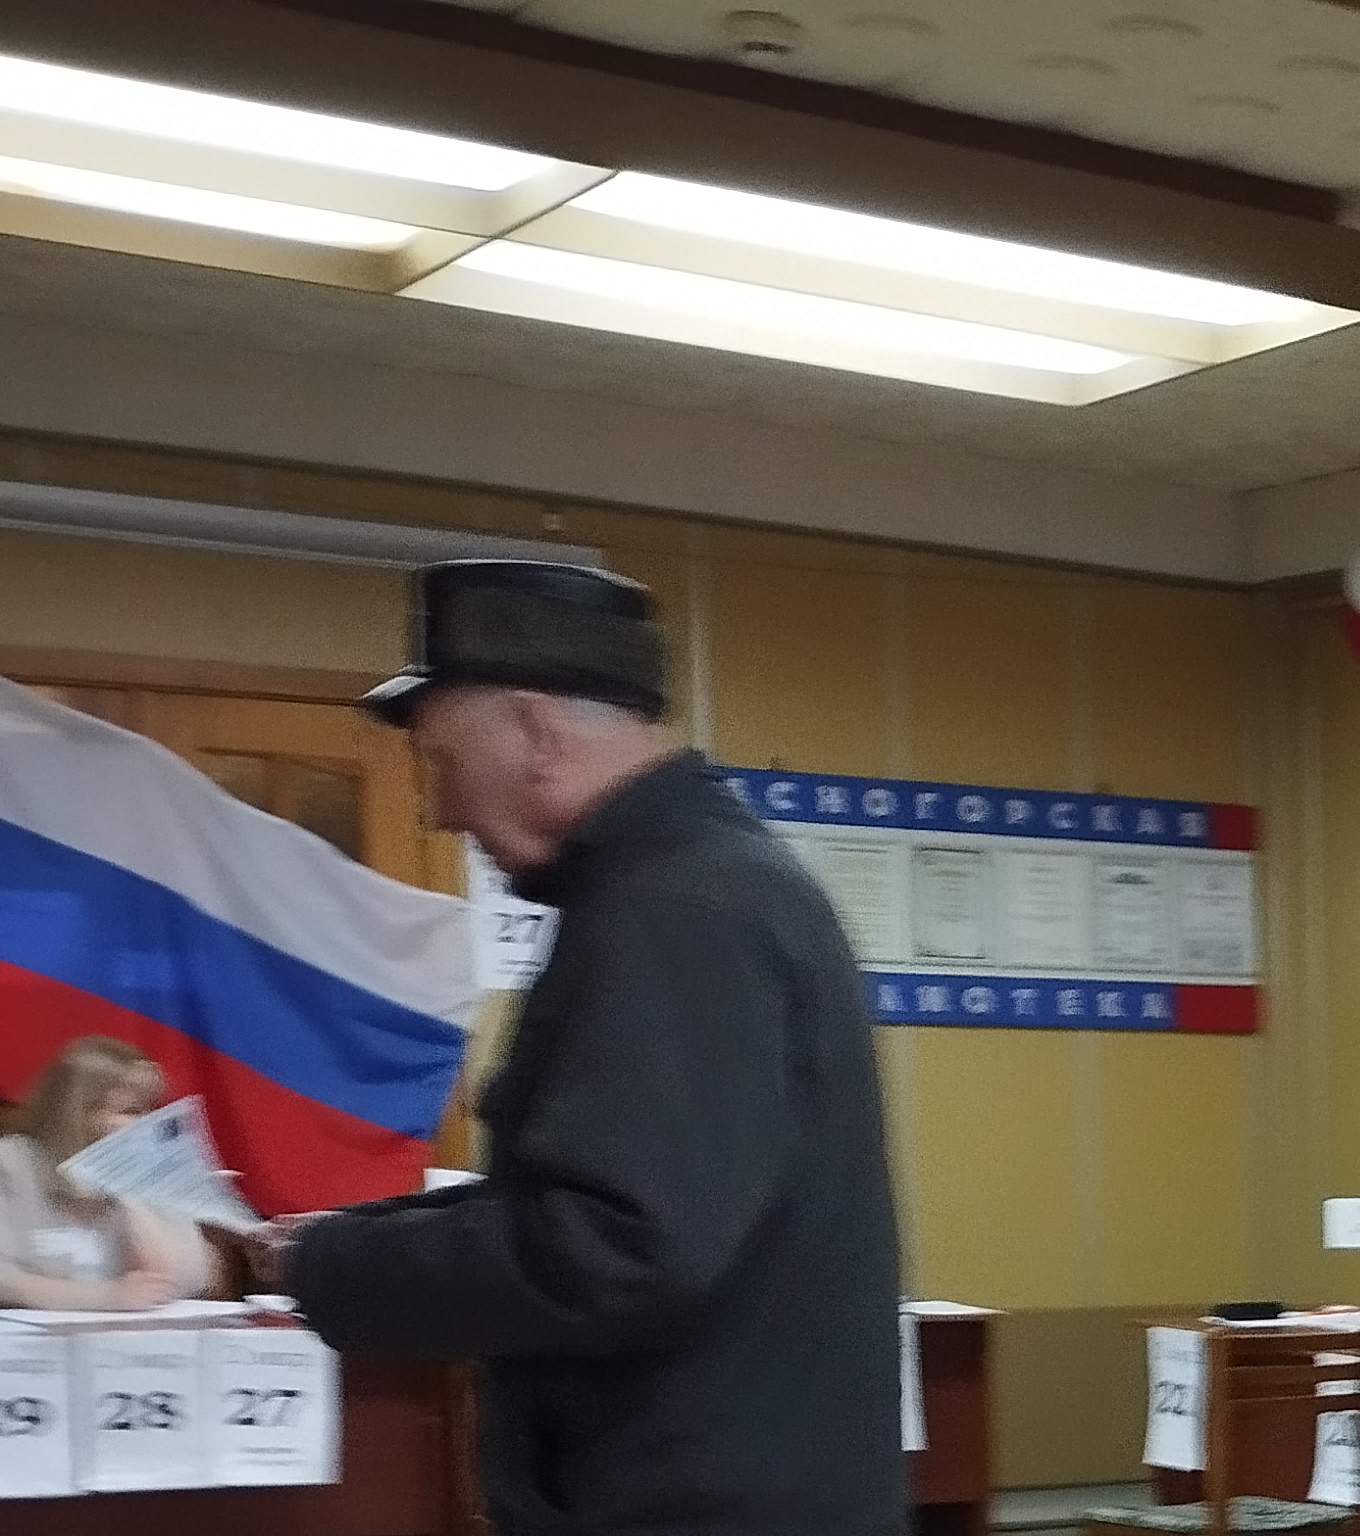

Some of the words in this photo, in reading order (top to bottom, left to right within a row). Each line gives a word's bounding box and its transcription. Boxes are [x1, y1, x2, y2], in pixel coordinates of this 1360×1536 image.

[492, 911, 546, 944] 27
[97, 1390, 188, 1432] 28
[222, 1387, 304, 1428] 27
